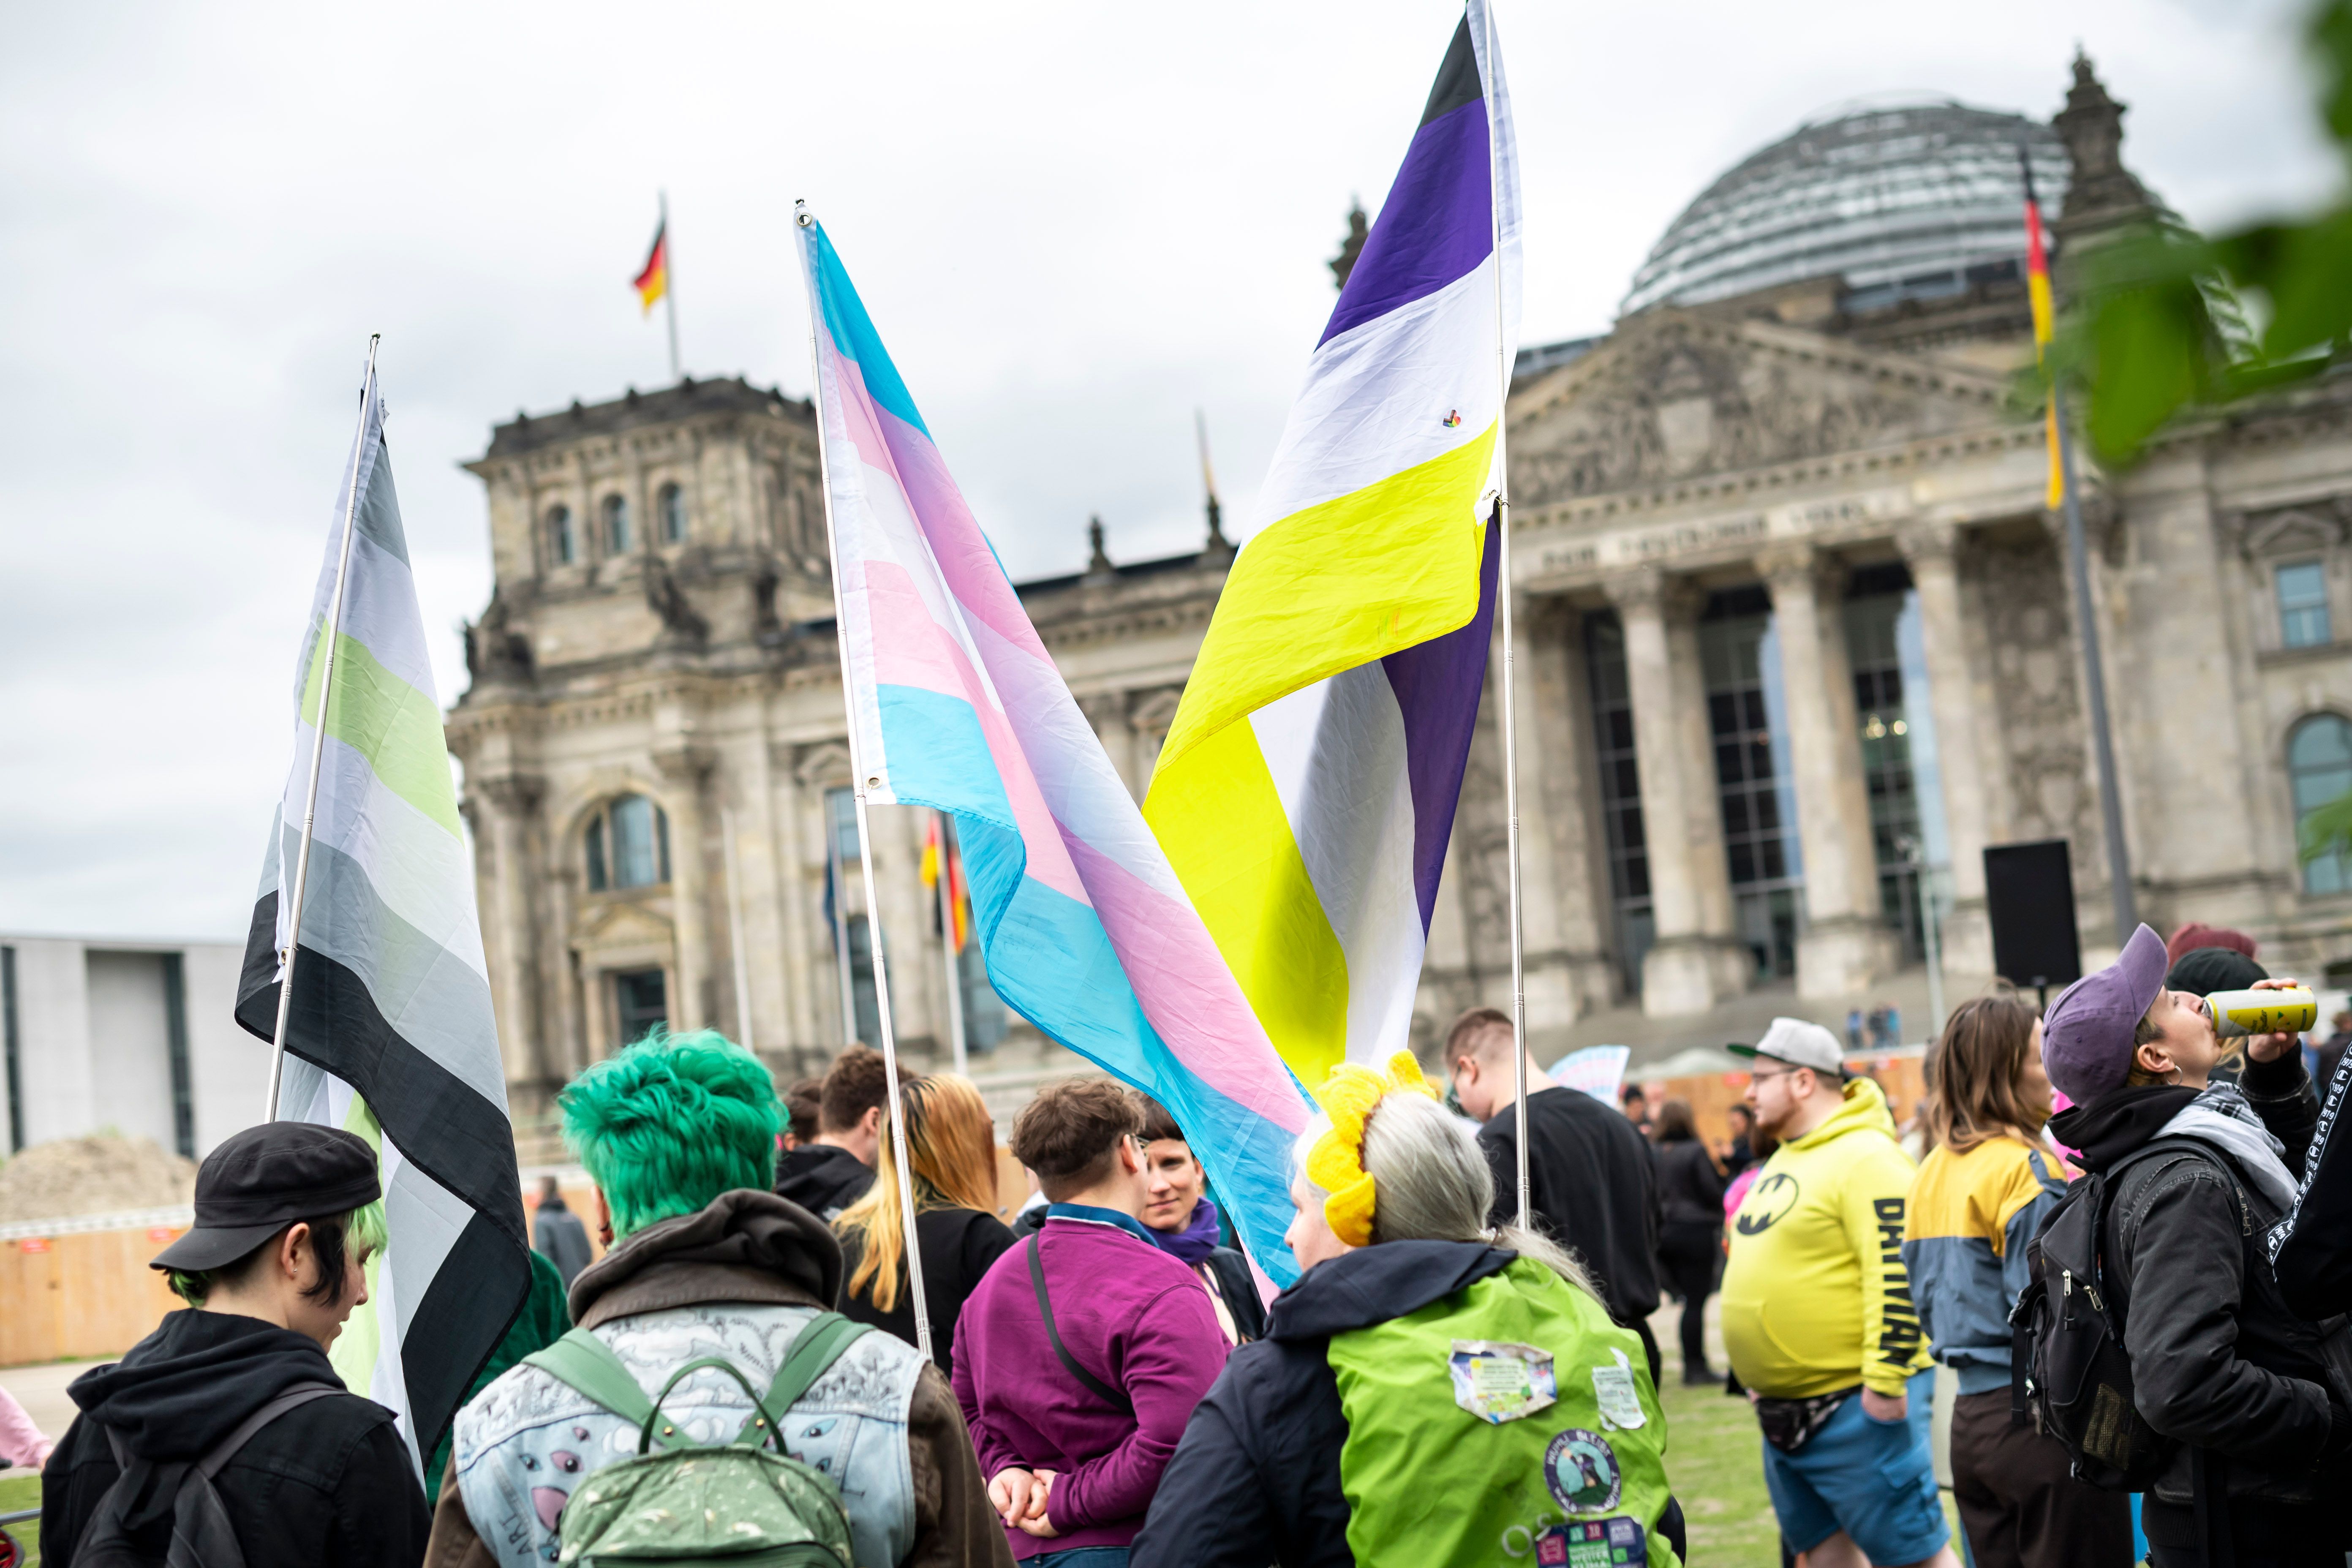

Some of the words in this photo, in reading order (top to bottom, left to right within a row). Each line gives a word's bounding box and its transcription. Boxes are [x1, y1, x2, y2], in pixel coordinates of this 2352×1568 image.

[2331, 1082, 2344, 1094] 1919
[2321, 1108, 2335, 1120] 1919
[2307, 1158, 2318, 1171] 1919
[2274, 1225, 2286, 1240] 1919
